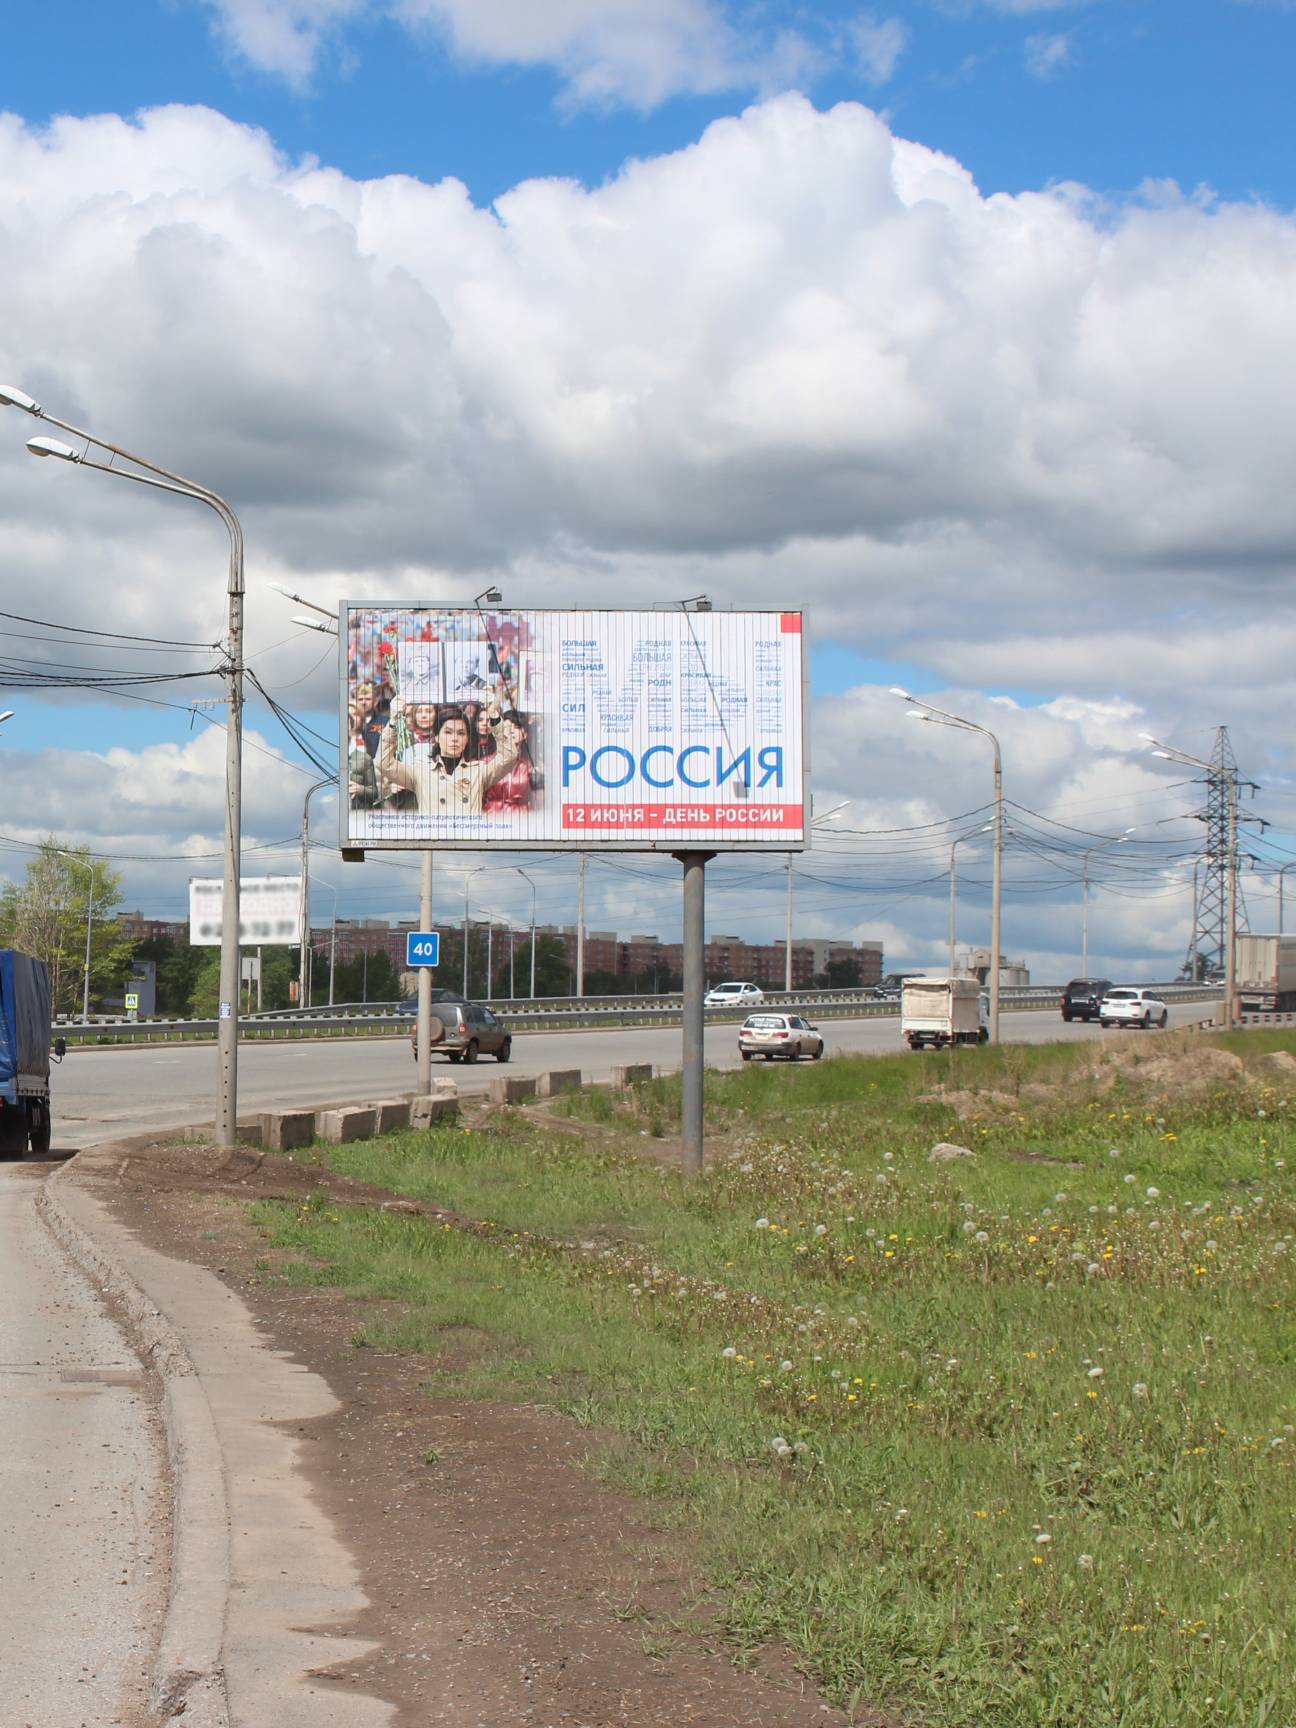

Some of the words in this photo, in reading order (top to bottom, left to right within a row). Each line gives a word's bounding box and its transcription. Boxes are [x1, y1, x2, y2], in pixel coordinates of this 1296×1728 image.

[561, 639, 597, 647] БОЛЬШАЯ
[632, 652, 672, 662] БОЛЬШАЯ
[561, 663, 604, 671] СИЛЬНАЯ
[647, 679, 672, 687] РОДН
[561, 703, 586, 712] СИЛ
[600, 713, 634, 721] КРАСИВАЯ
[562, 745, 783, 789] РОССИЯ
[567, 808, 585, 822] 12
[590, 808, 644, 822] ИЮНЯ
[663, 808, 710, 825] ДЕНЬ
[715, 808, 784, 822] РОССИИ
[413, 942, 433, 956] 40
